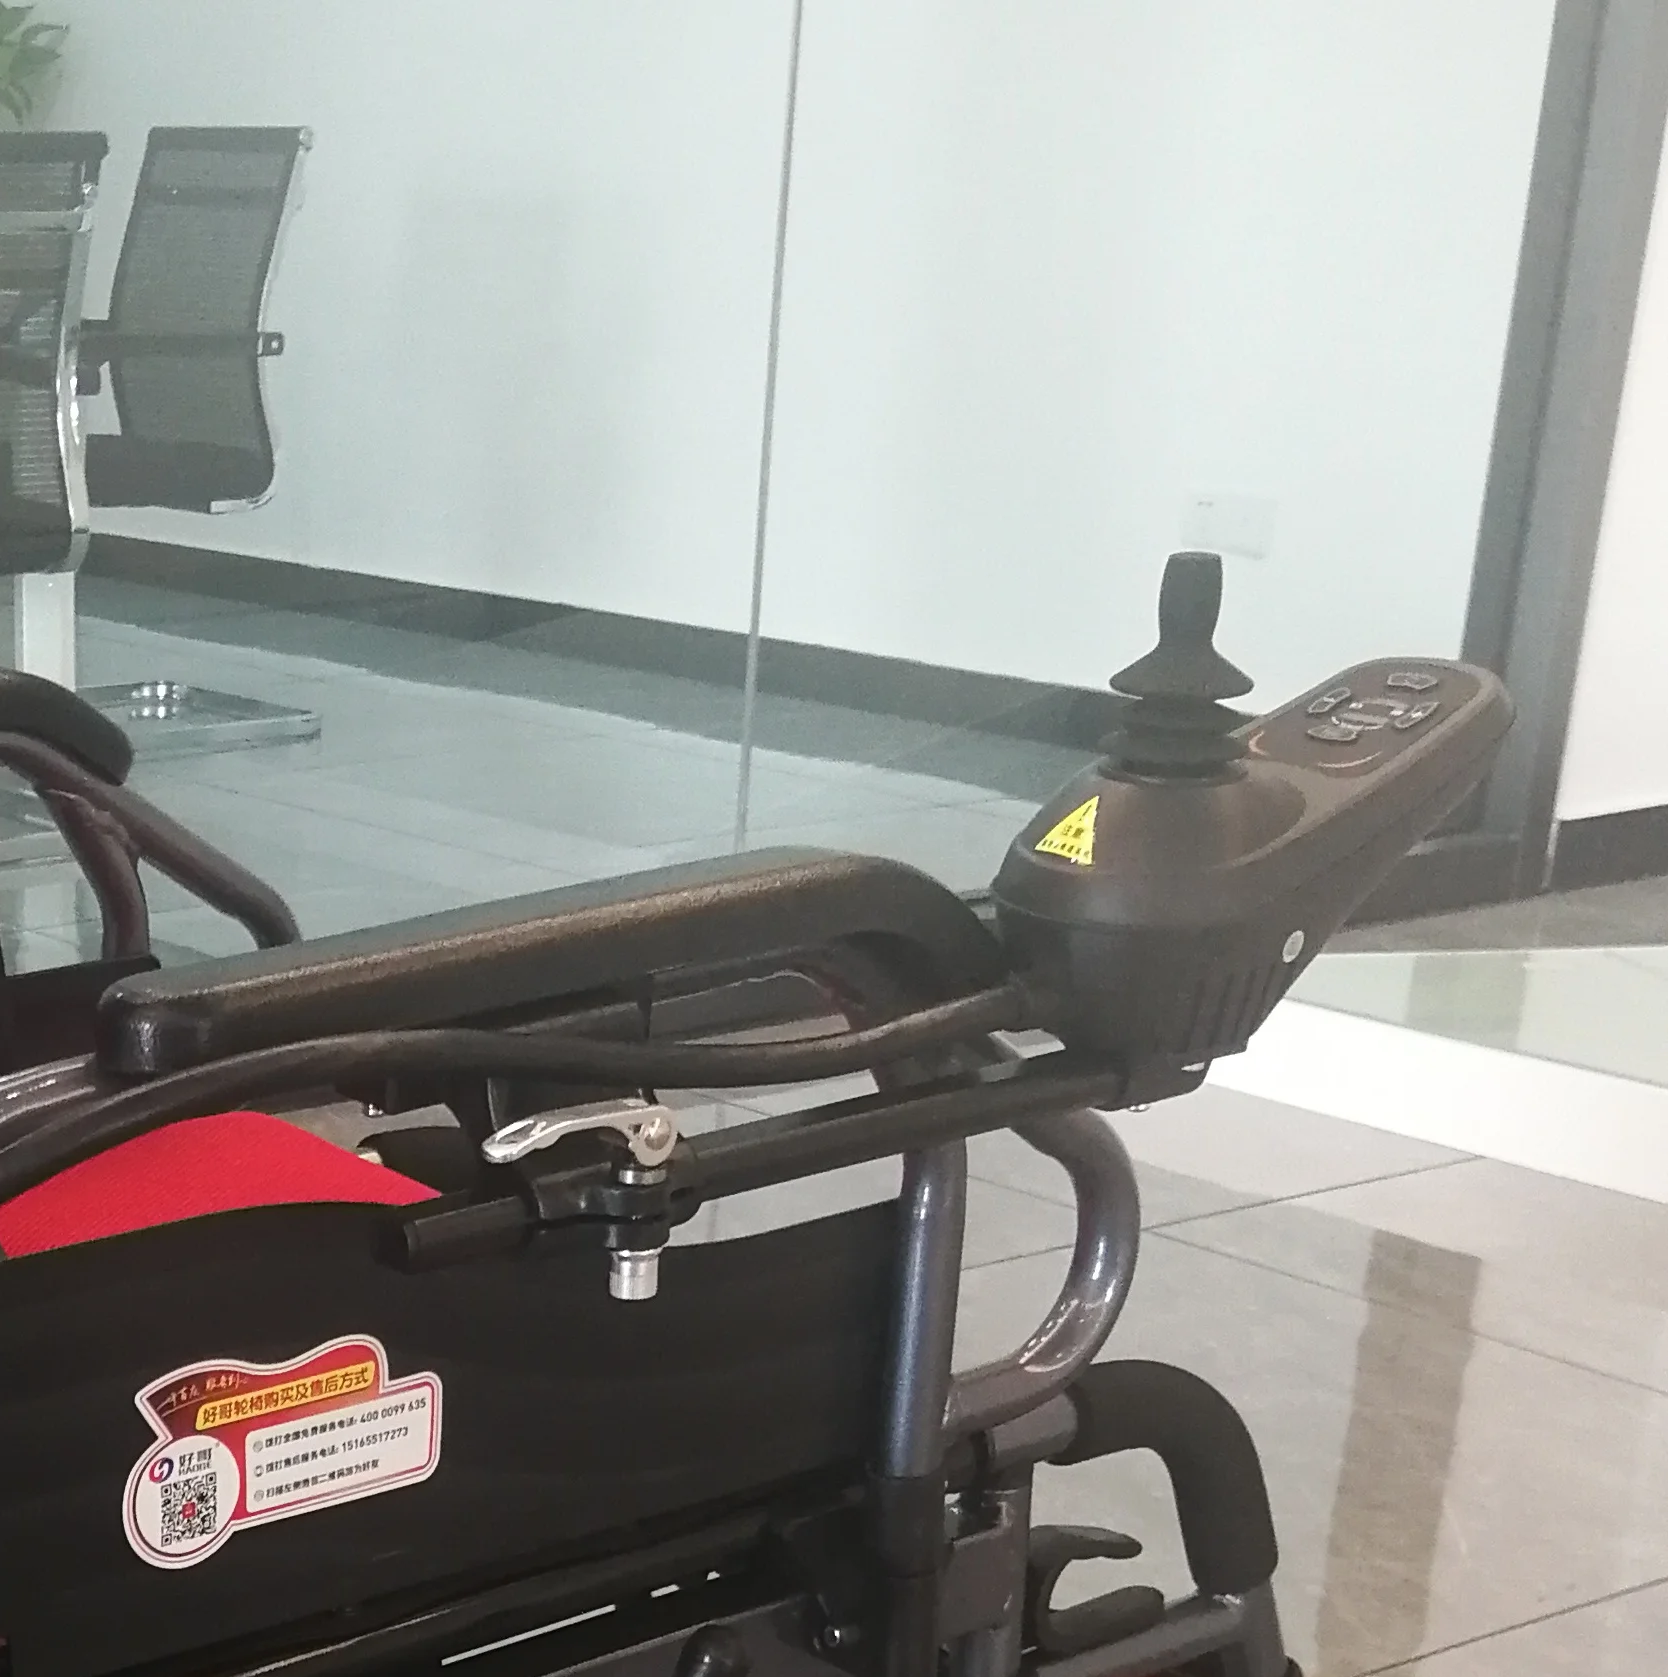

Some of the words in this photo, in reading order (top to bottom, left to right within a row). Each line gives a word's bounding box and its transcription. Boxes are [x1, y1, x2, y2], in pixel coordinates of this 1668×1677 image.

[202, 1366, 369, 1426] 好哥轮椅购买及售后方式
[360, 1410, 379, 1423] 400
[381, 1403, 406, 1419] 0099
[408, 1397, 427, 1412] 635
[342, 1426, 409, 1452] 15165517273
